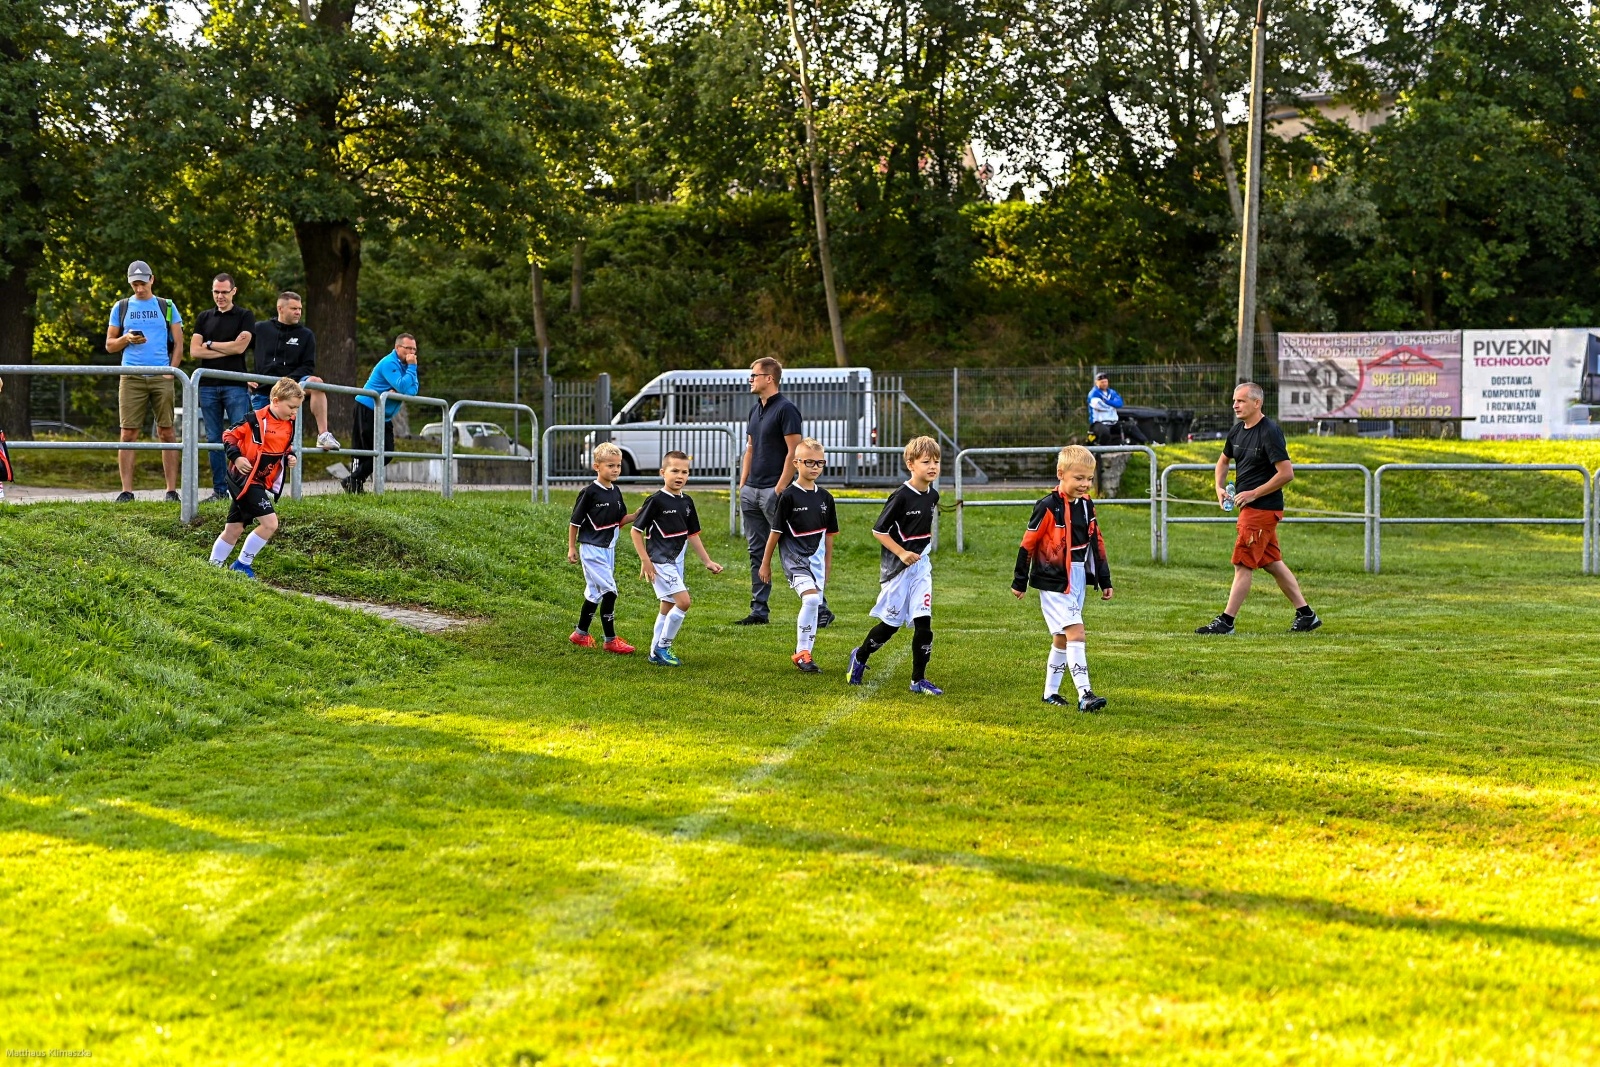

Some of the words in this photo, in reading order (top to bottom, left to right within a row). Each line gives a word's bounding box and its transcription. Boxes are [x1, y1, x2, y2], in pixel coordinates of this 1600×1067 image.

[130, 311, 141, 319] BIG
[142, 310, 158, 319] STAR
[1324, 335, 1386, 347] CIESIELSKO
[1394, 334, 1458, 346] DEKARSKIE
[1282, 347, 1316, 358] DOMY
[1318, 347, 1341, 357] POD
[1473, 340, 1552, 356] PIVEXIN
[1474, 357, 1551, 367] TECHNOLOGY
[1491, 376, 1533, 386] DOSTAWCA
[1482, 388, 1542, 398] KOMPONENTÓW
[1378, 405, 1401, 417] 698
[1404, 405, 1426, 417] 650
[1429, 405, 1452, 417] 692
[1491, 401, 1537, 412] ROZWIĄZAŃ
[1480, 415, 1495, 424] DLA
[1497, 415, 1543, 424] PRZEMYSŁU
